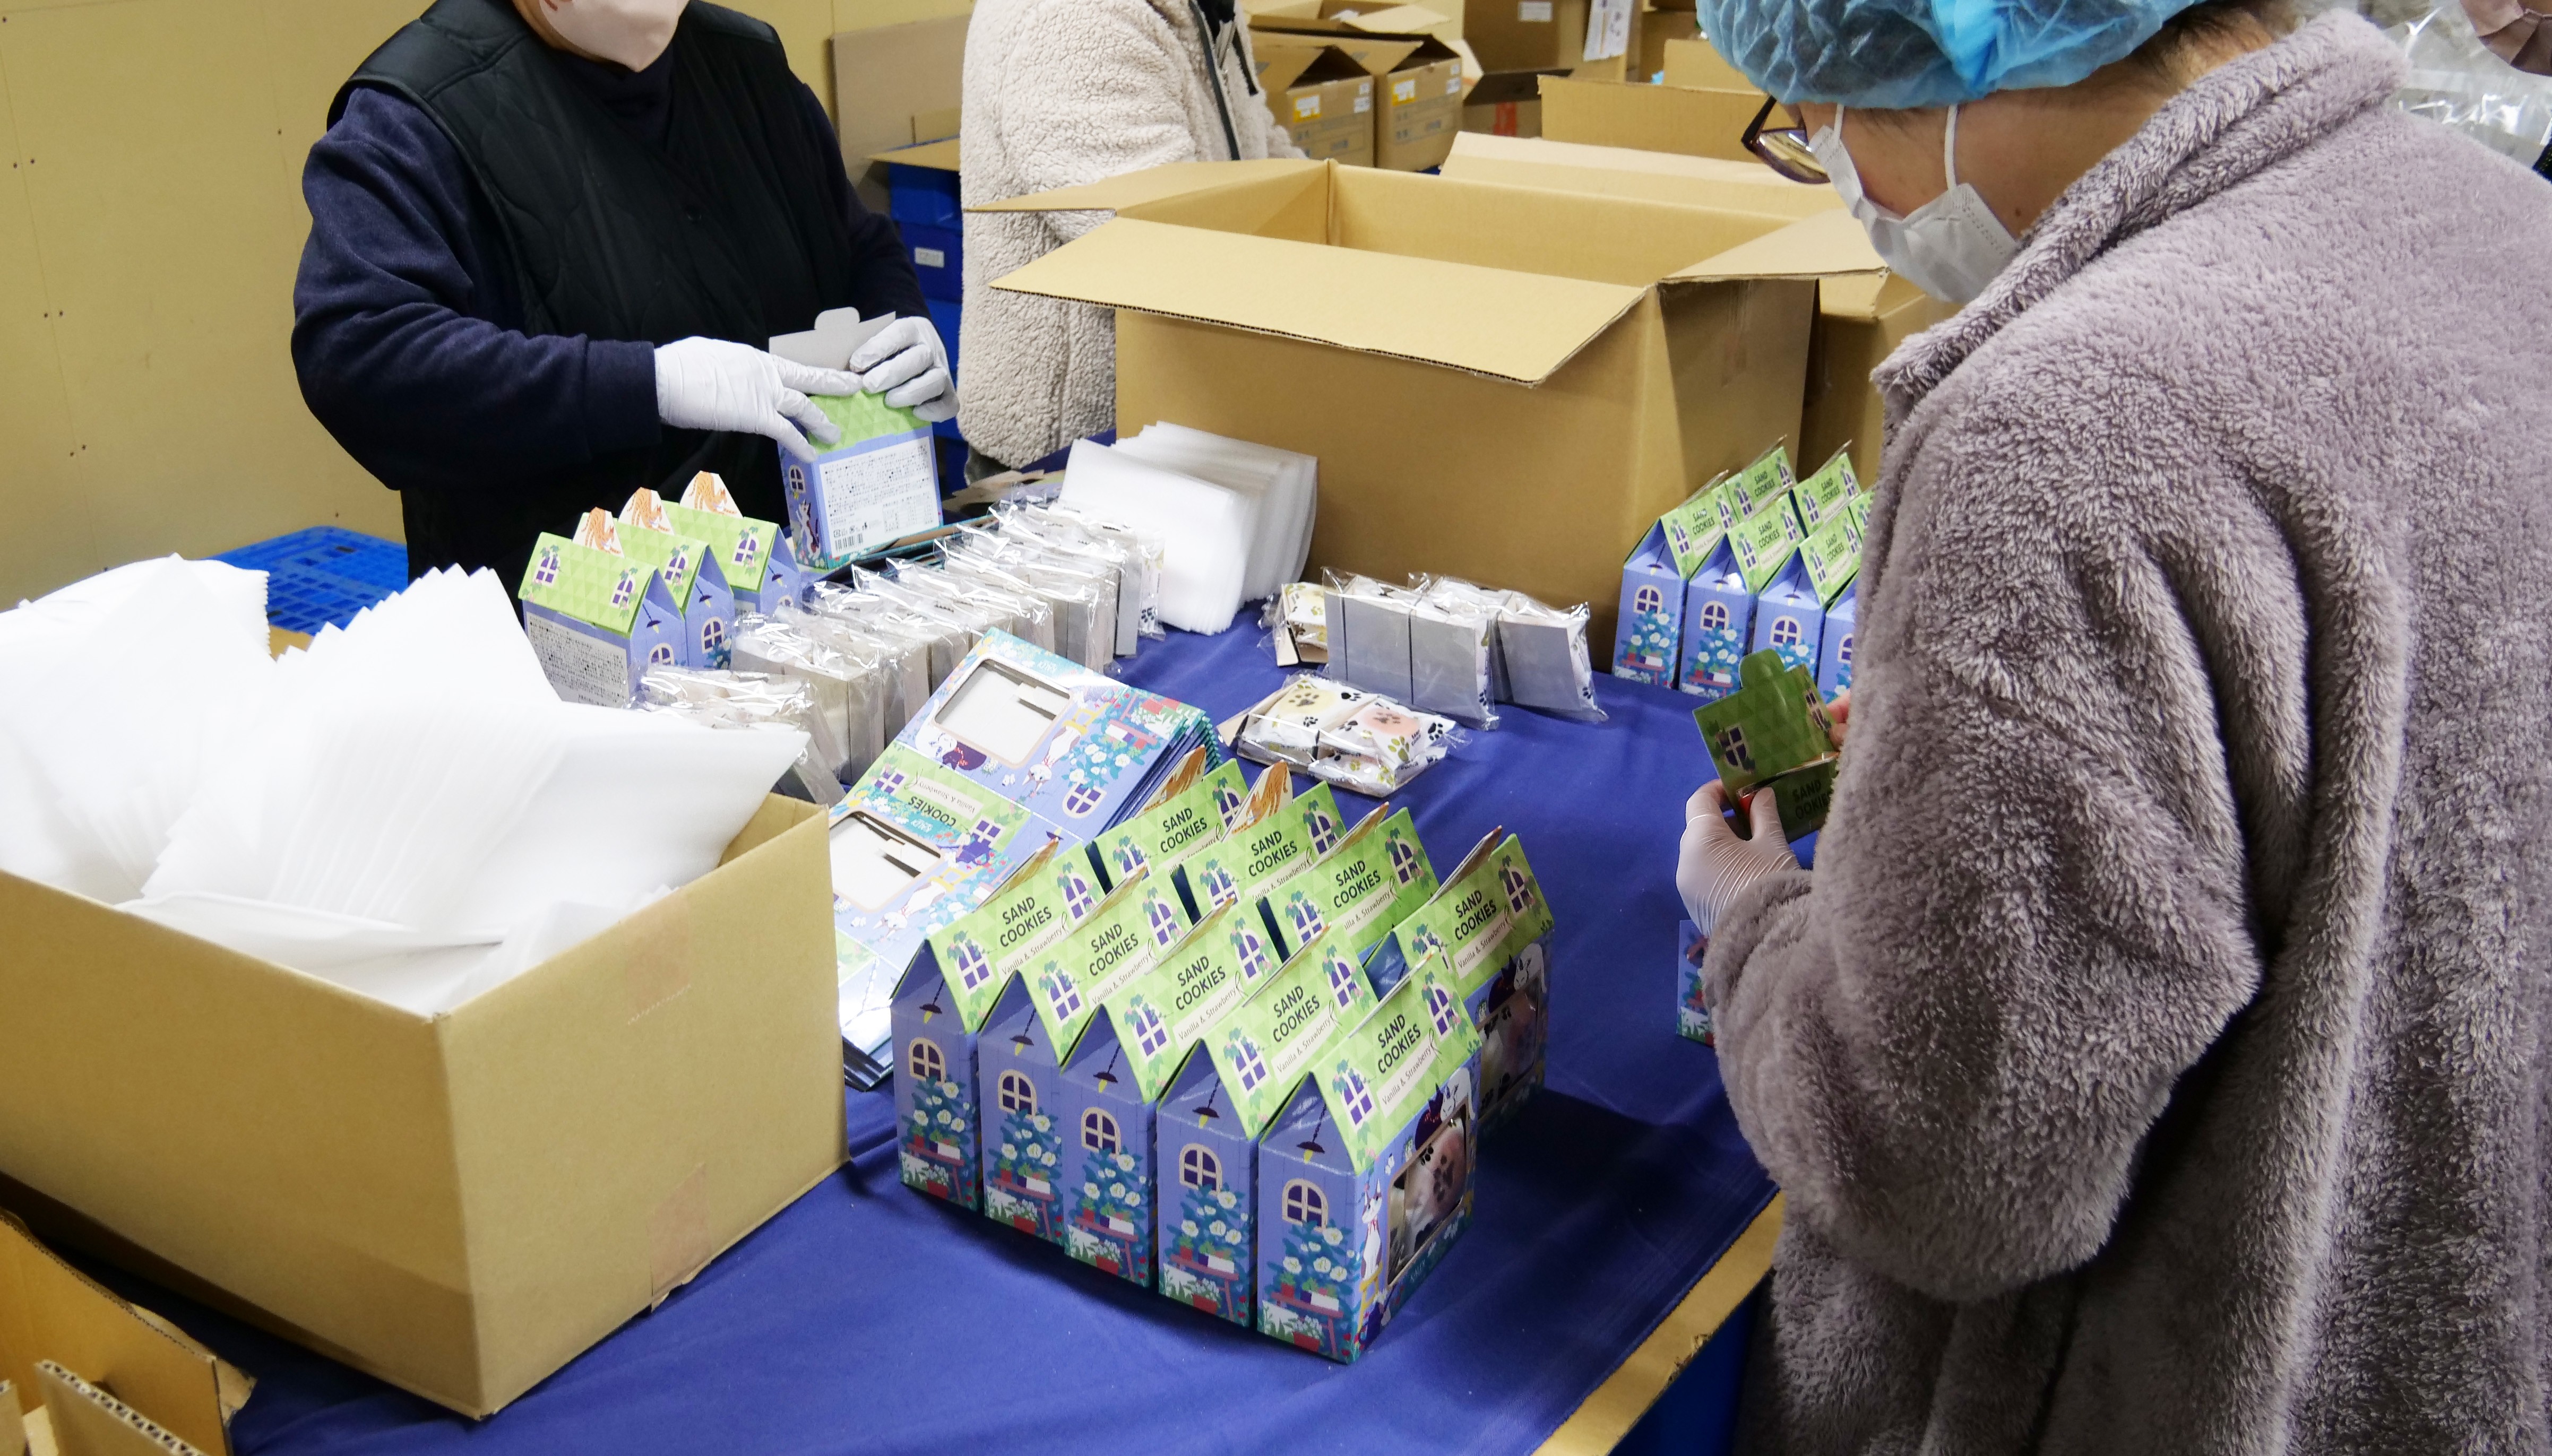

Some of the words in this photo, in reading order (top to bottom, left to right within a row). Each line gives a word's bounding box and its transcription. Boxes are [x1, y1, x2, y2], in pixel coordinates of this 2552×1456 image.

[1692, 516, 1715, 535] COOKIES
[1693, 508, 1707, 522] SAND
[1758, 521, 1772, 535] SAND
[1758, 529, 1780, 548] COOKIES
[1826, 534, 1837, 548] SAND
[1826, 542, 1844, 562] COOKIES
[1792, 779, 1821, 803] SAND
[1795, 790, 1833, 819] OOKIE
[908, 796, 956, 827] COOKIES
[1162, 807, 1192, 833] SAND
[1160, 817, 1208, 853] COOKIES
[1251, 830, 1282, 856] SAND
[1248, 840, 1298, 877] COOKIES
[1277, 860, 1306, 886] Strawberry
[1335, 860, 1366, 887] SAND
[1333, 870, 1381, 908] COOKIES
[1361, 890, 1390, 917] Strawberry
[1455, 889, 1482, 918] SAND
[1002, 896, 1035, 924] SAND
[1455, 899, 1497, 940] COOKIES
[1000, 906, 1052, 947] COOKIES
[1091, 923, 1122, 953] SAND
[1002, 957, 1024, 975] Vanilla
[1031, 928, 1062, 955] Strawberry
[1089, 933, 1139, 976] COOKIES
[1458, 951, 1476, 968] Vanilla
[1476, 946, 1481, 955] &
[1480, 922, 1506, 949] Strawberry
[1092, 987, 1113, 1005] Vanilla
[1119, 955, 1149, 982] Strawberry
[1177, 956, 1209, 986] SAND
[1176, 966, 1226, 1010] COOKIES
[1273, 985, 1304, 1018] SAND
[1178, 1021, 1200, 1040] Vanilla
[1200, 1014, 1206, 1023] &
[1206, 988, 1237, 1018] Strawberry
[1273, 994, 1320, 1042] COOKIES
[1277, 1053, 1297, 1073] Vanilla
[1297, 1046, 1303, 1055] &
[1303, 1019, 1331, 1050] Strawberry
[1377, 1014, 1406, 1048] SAND
[1377, 1024, 1421, 1074] COOKIES
[1382, 1082, 1400, 1105] Vanilla
[1400, 1076, 1406, 1086] &
[1406, 1046, 1432, 1080] Strawberry
